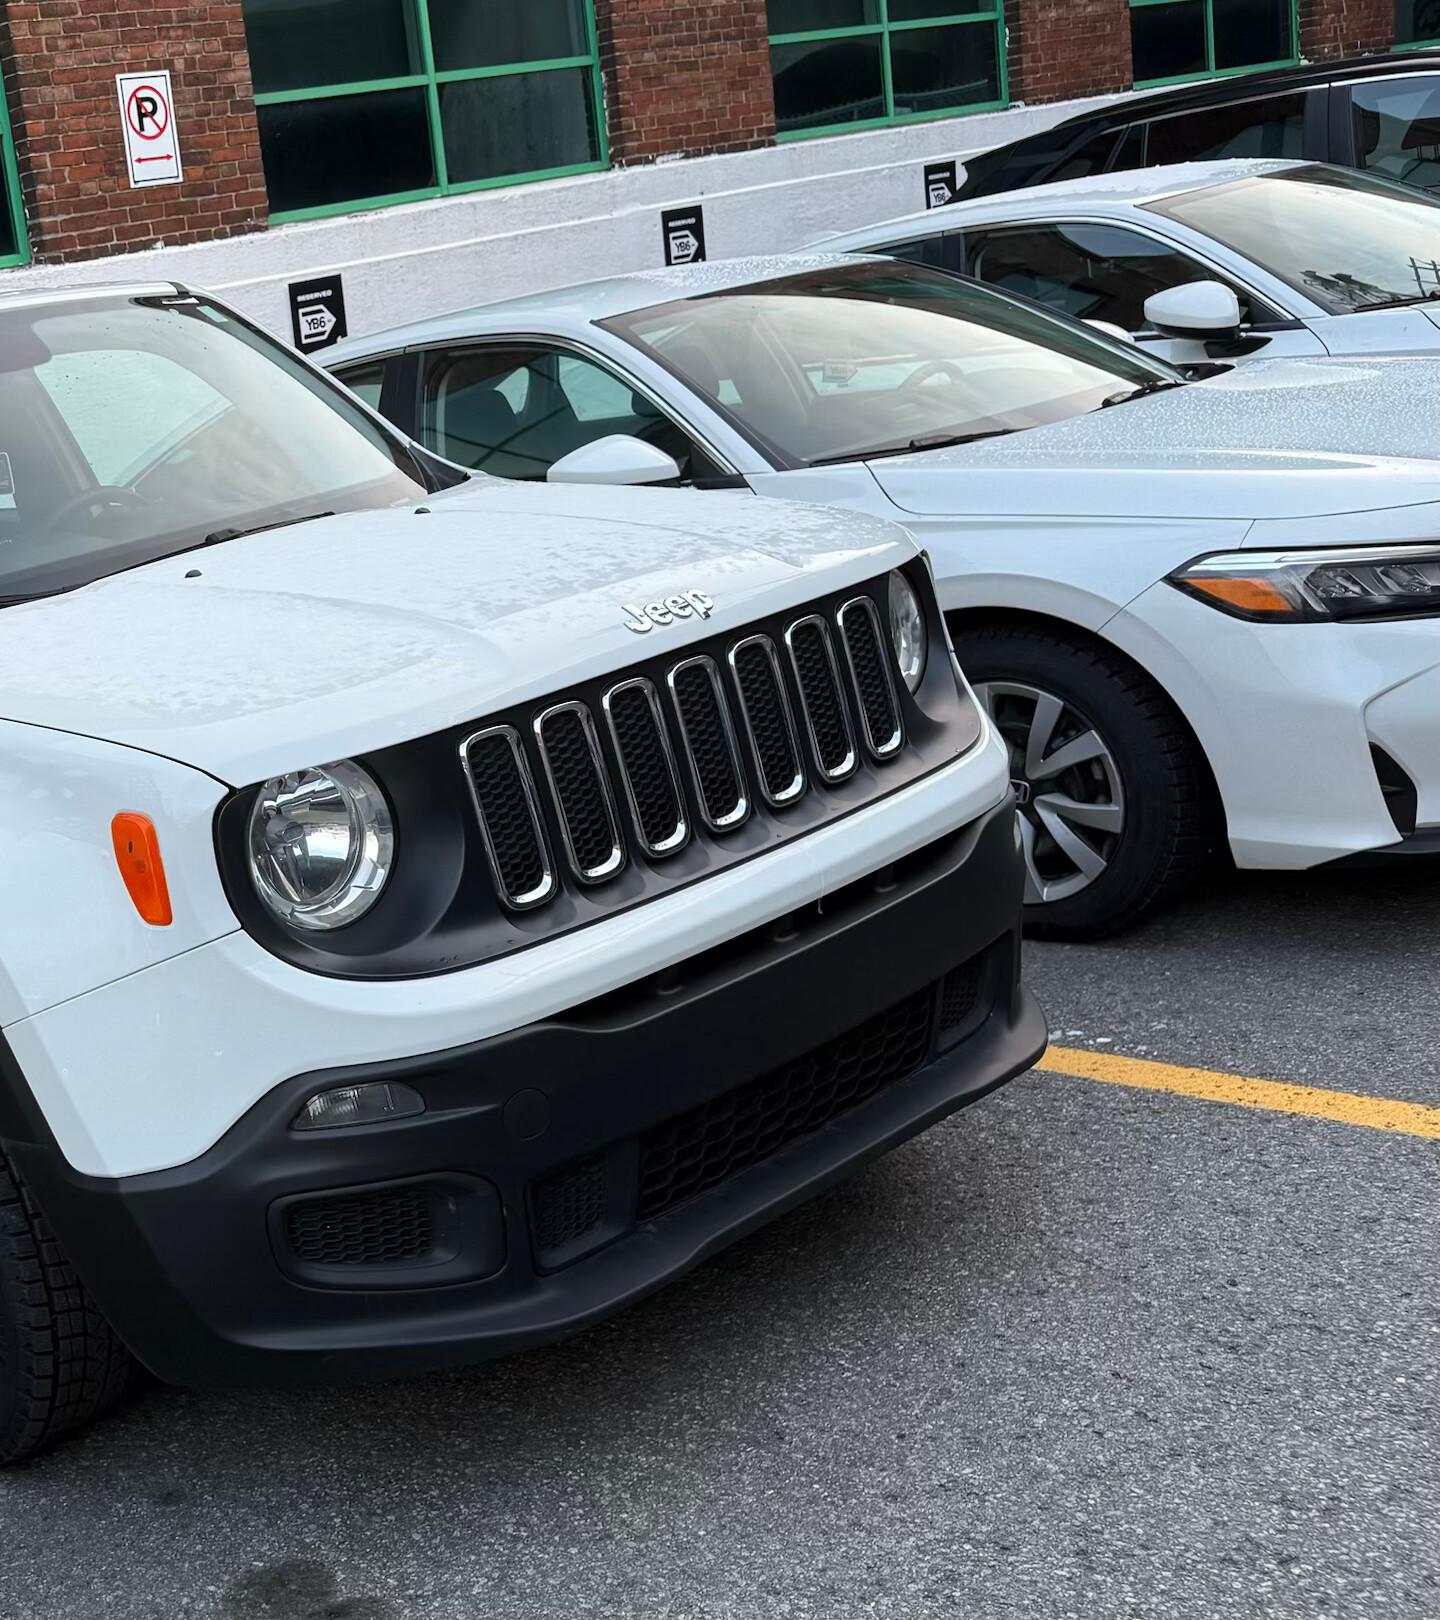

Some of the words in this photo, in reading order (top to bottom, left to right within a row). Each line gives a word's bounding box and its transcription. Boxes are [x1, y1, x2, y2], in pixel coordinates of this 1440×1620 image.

[136, 96, 158, 132] P
[296, 289, 333, 302] RESERVED
[305, 316, 326, 331] YB6
[621, 589, 714, 634] Jeep
